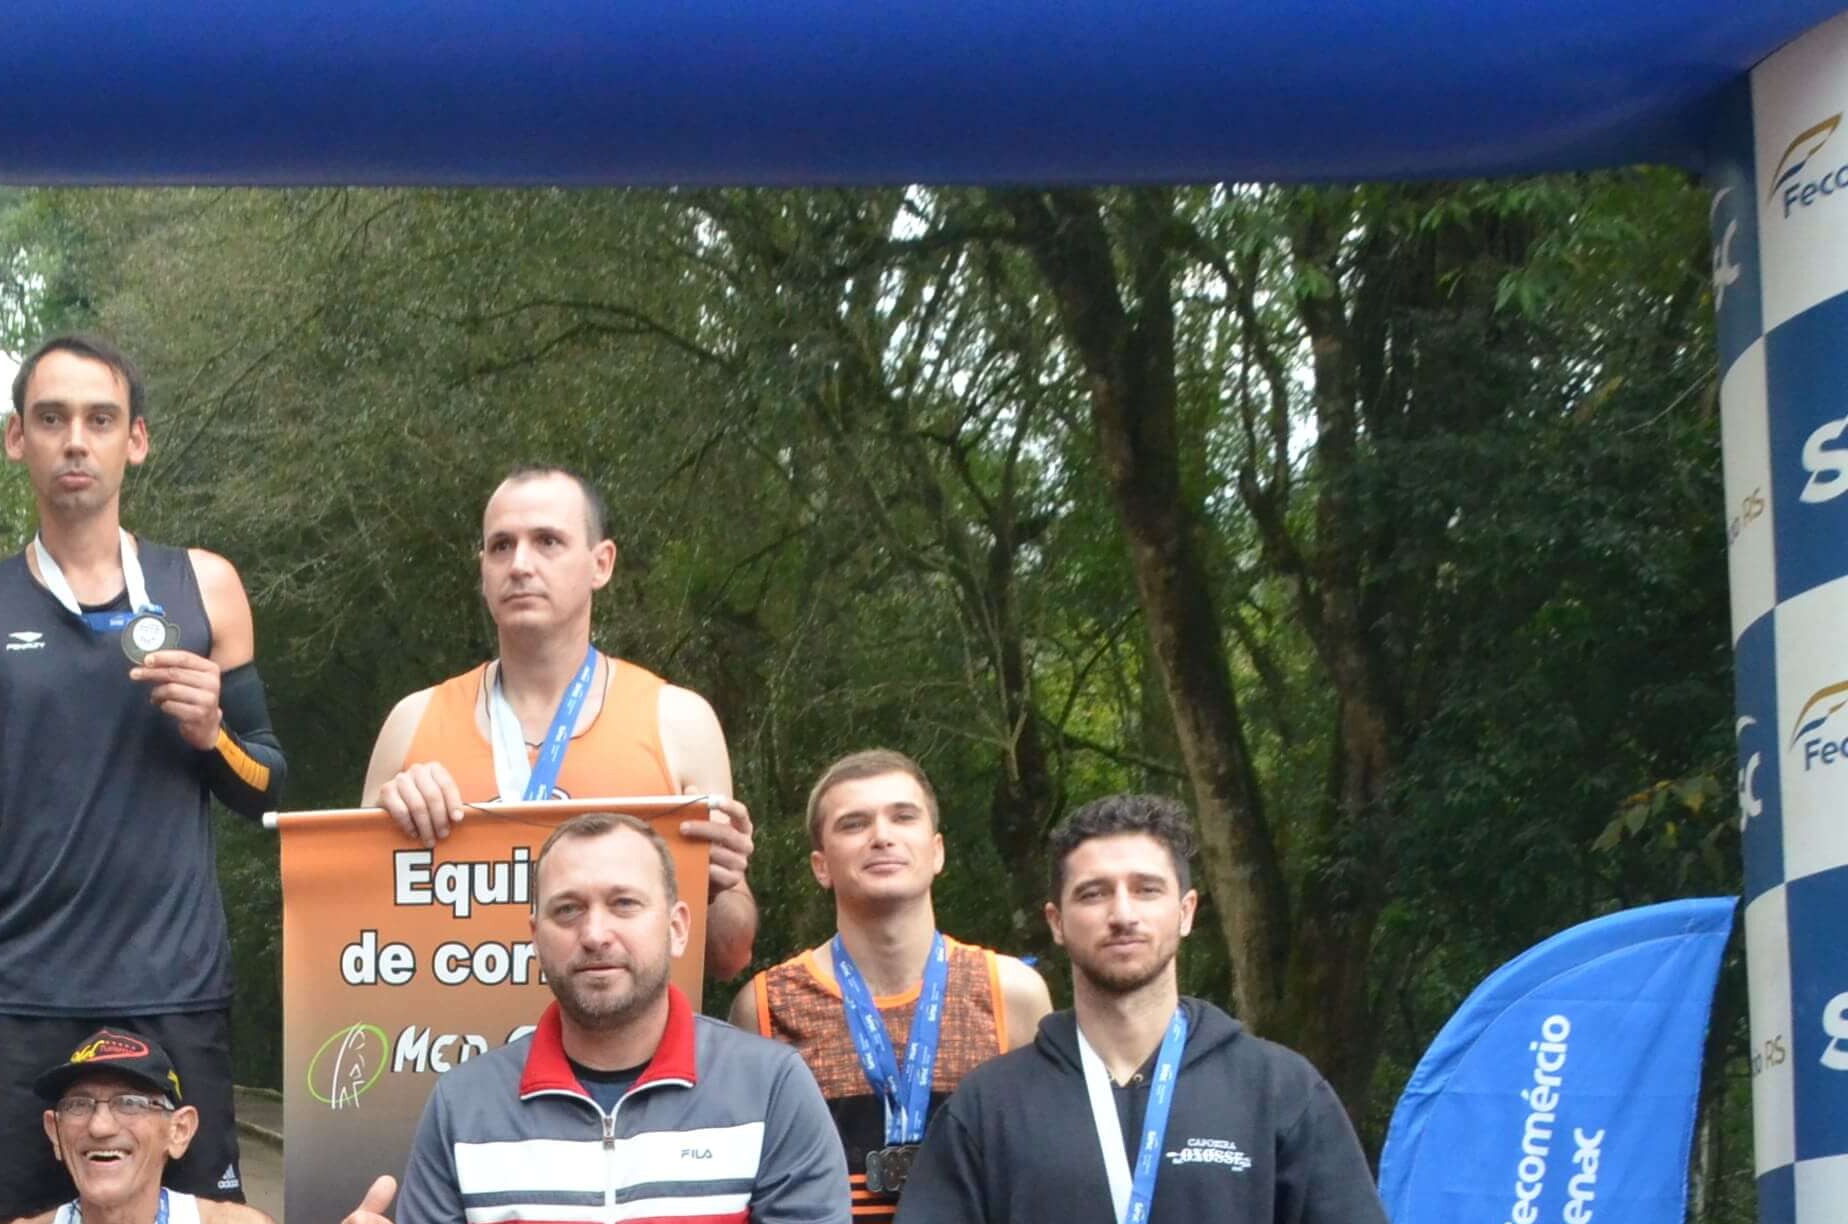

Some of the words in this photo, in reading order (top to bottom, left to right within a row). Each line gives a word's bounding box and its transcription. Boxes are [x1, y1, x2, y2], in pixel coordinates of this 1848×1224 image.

[393, 847, 536, 918] Equi
[341, 929, 416, 985] de
[433, 941, 548, 985] cor
[680, 1149, 713, 1159] FILA
